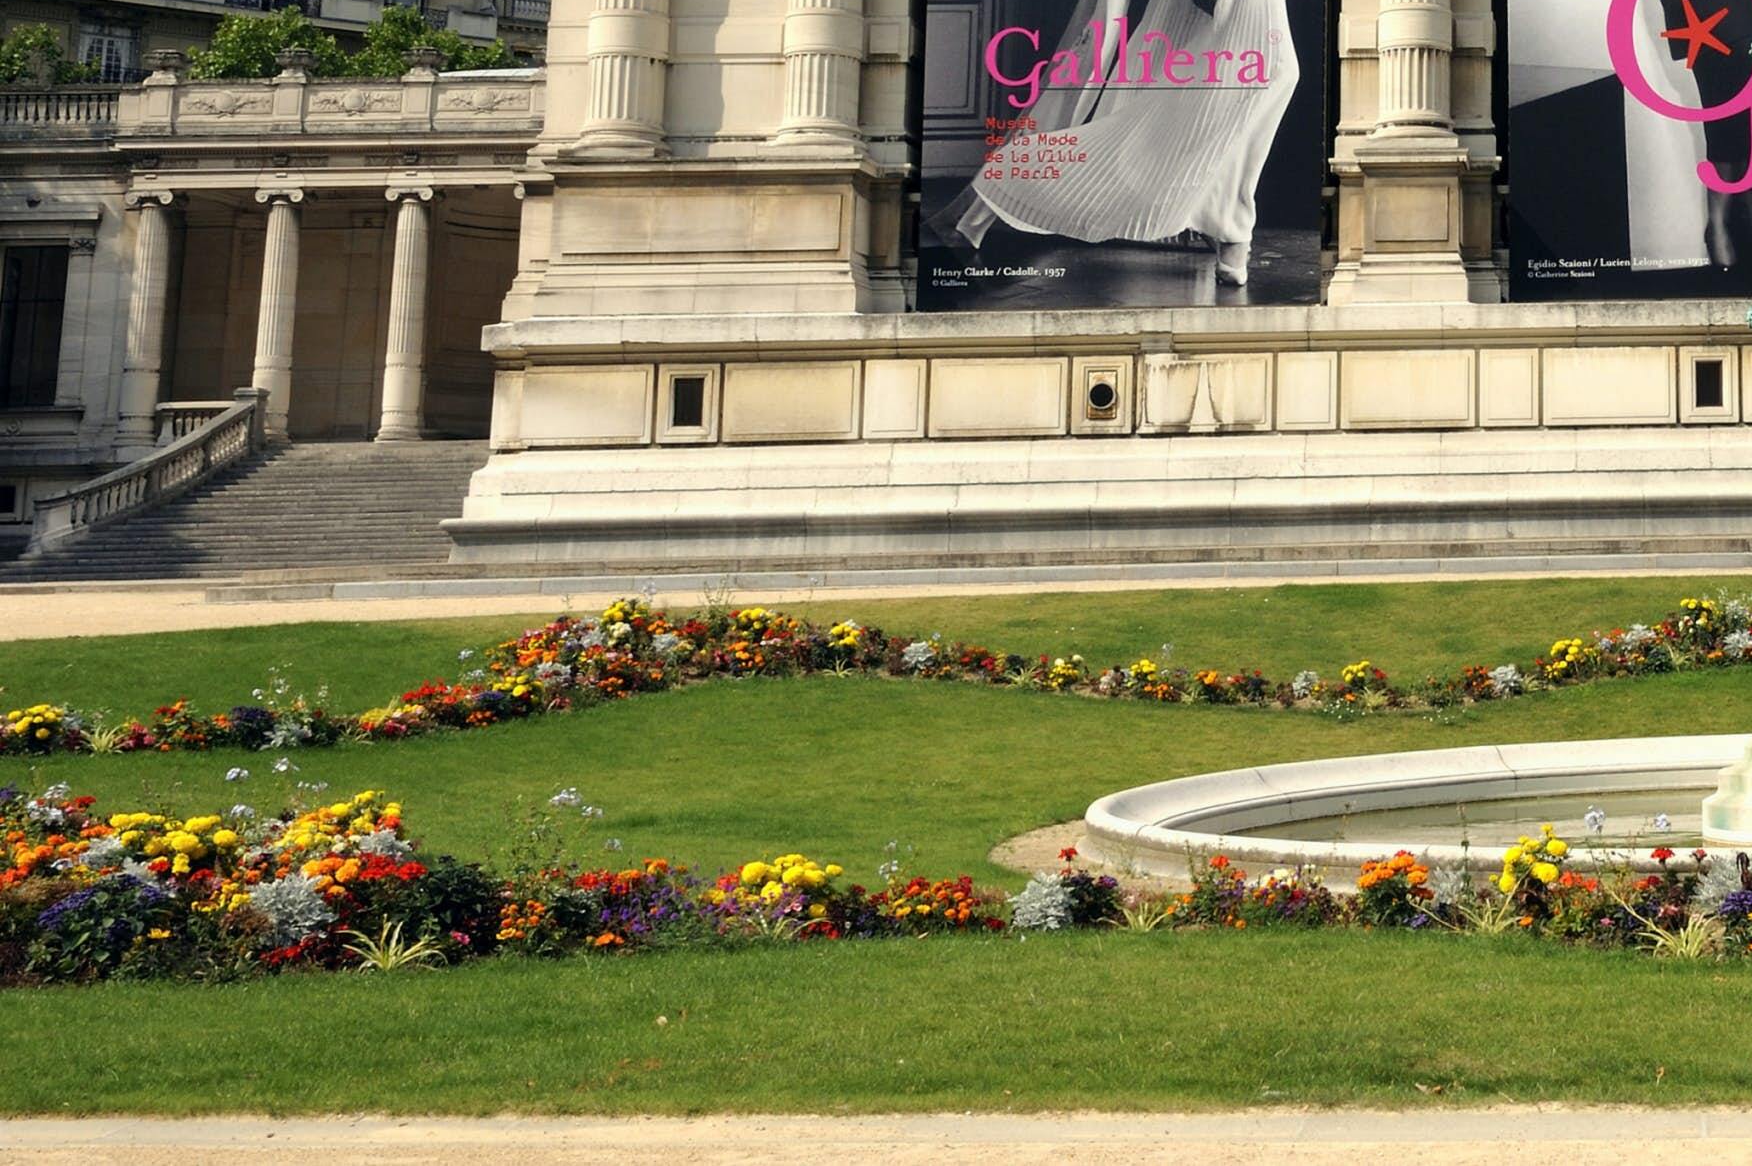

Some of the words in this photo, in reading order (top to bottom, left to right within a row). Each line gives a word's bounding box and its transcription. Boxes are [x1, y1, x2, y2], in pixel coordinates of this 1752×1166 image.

[984, 15, 1270, 109] Galliera
[985, 115, 1037, 130] Musée
[985, 134, 1006, 147] de
[1012, 134, 1031, 147] la
[1037, 133, 1079, 146] Mode
[984, 150, 1004, 163] de
[1011, 150, 1030, 163] la
[1037, 149, 1088, 163] Ville
[984, 167, 1003, 180] de
[1010, 166, 1062, 180] Paris
[1527, 259, 1557, 271] Egidio
[1558, 258, 1592, 268] Scaioni
[1600, 257, 1631, 267] Lucien
[933, 268, 962, 280] Henry
[964, 267, 994, 276] Clarke
[1003, 266, 1042, 277] Cadolle,
[1044, 267, 1067, 278] 1957
[1535, 270, 1569, 278] Catherine
[1570, 270, 1596, 278] Scaioni
